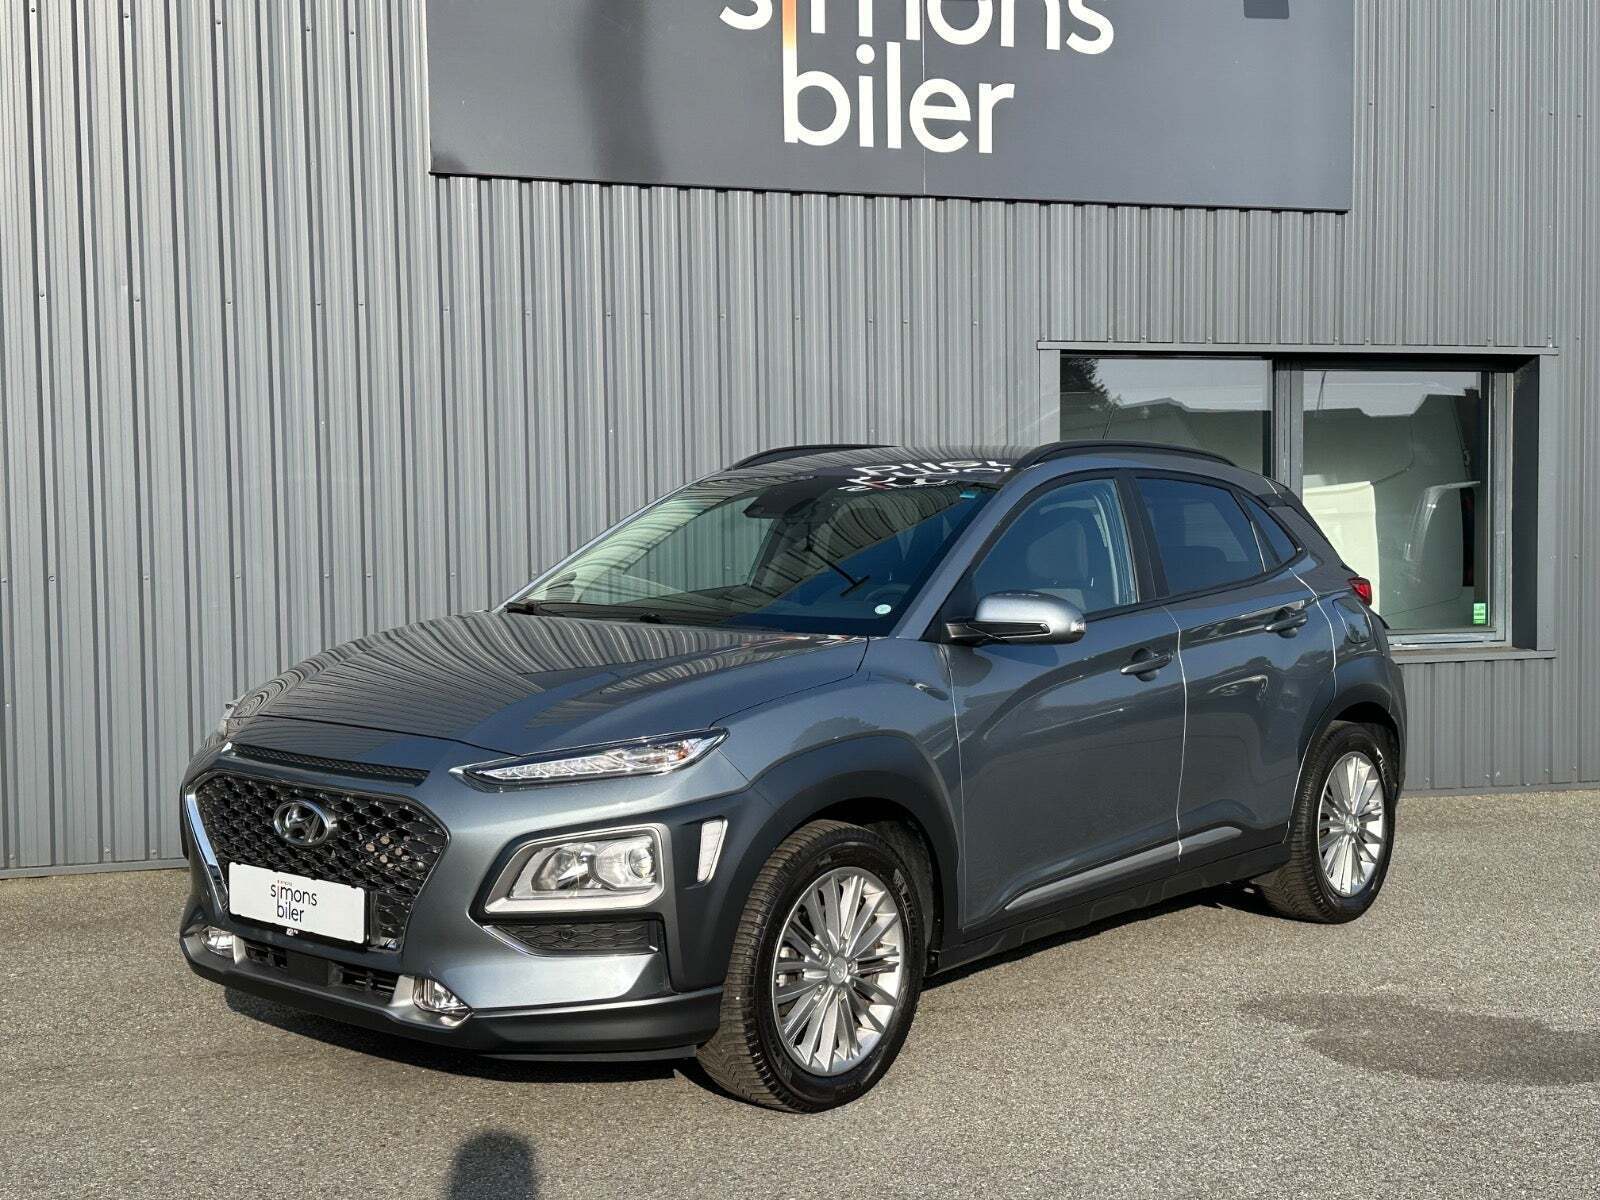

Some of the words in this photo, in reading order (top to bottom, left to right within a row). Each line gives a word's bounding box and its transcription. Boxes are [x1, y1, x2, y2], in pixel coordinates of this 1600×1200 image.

[783, 42, 1015, 154] biler
[270, 881, 318, 906] simons
[277, 900, 304, 922] biler
